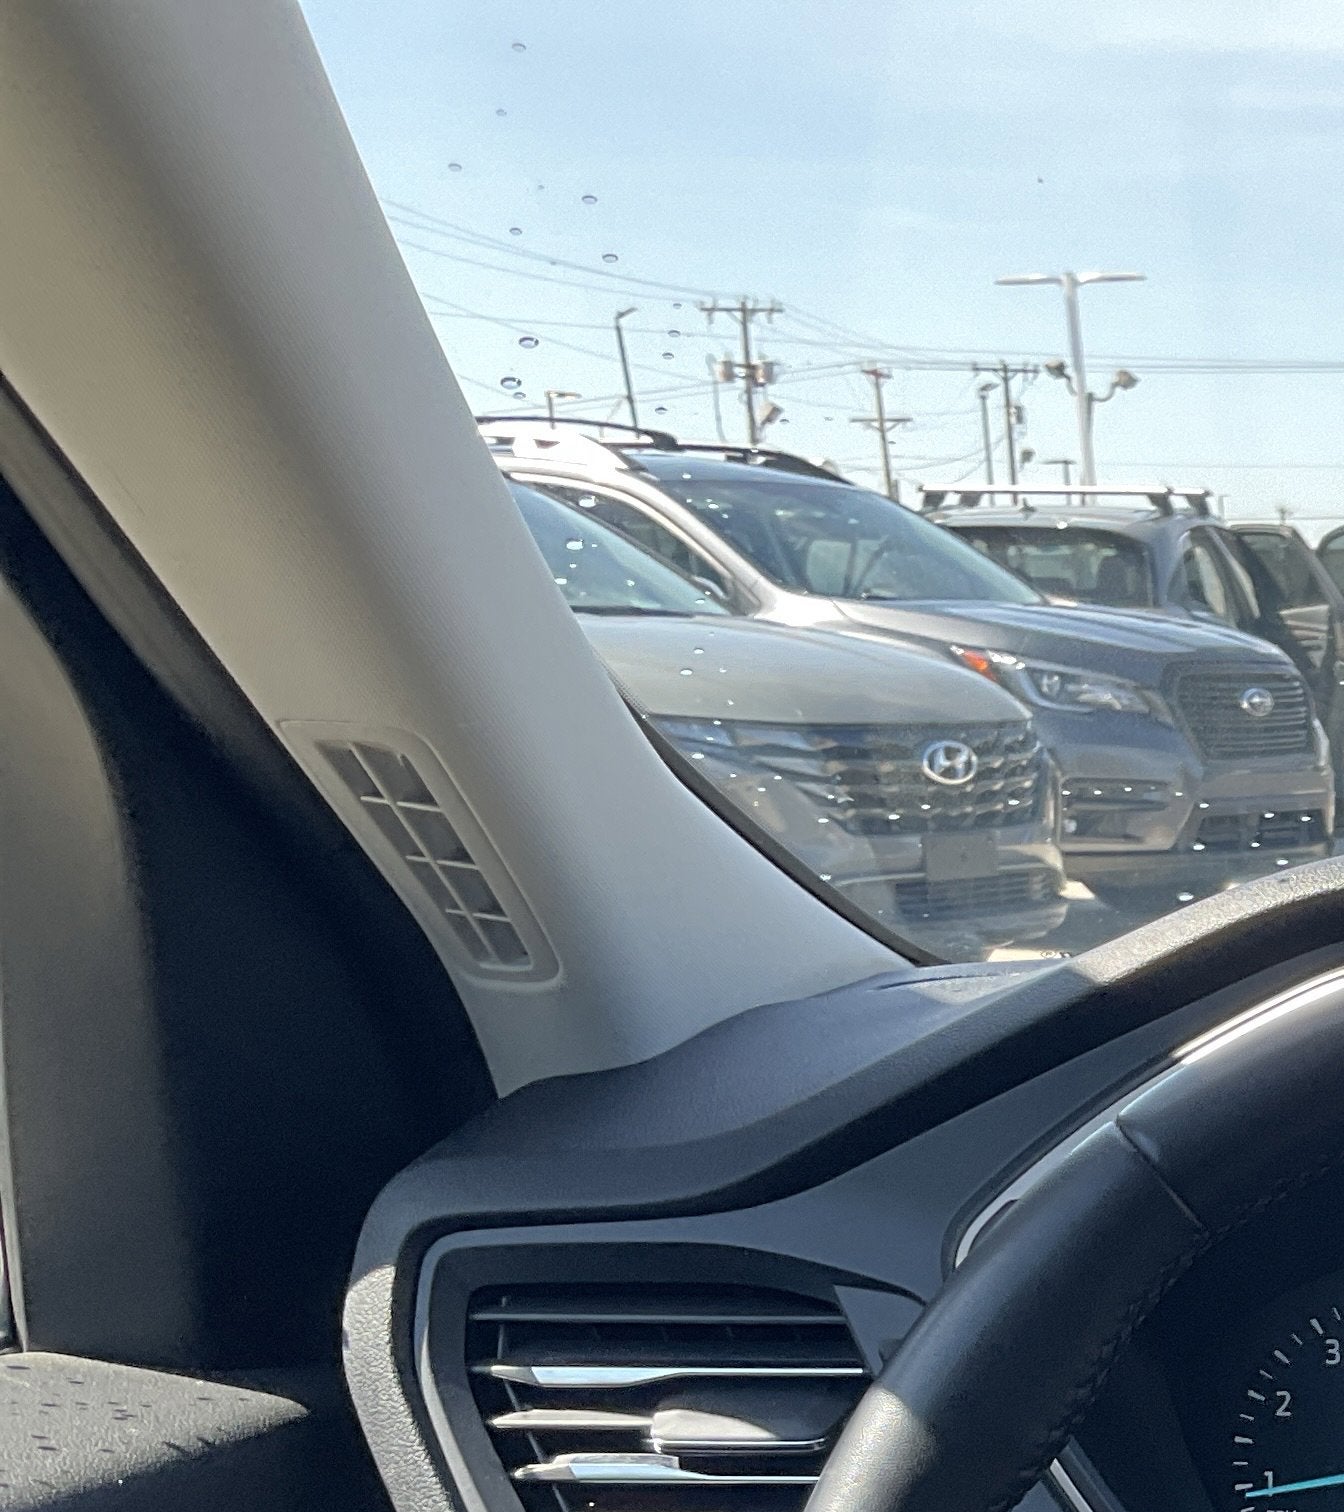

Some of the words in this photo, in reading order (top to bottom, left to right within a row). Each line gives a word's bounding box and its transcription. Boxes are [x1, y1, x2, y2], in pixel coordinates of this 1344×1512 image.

[1325, 1339, 1341, 1365] 3
[1276, 1391, 1292, 1416] 2
[1264, 1471, 1273, 1497] 1
